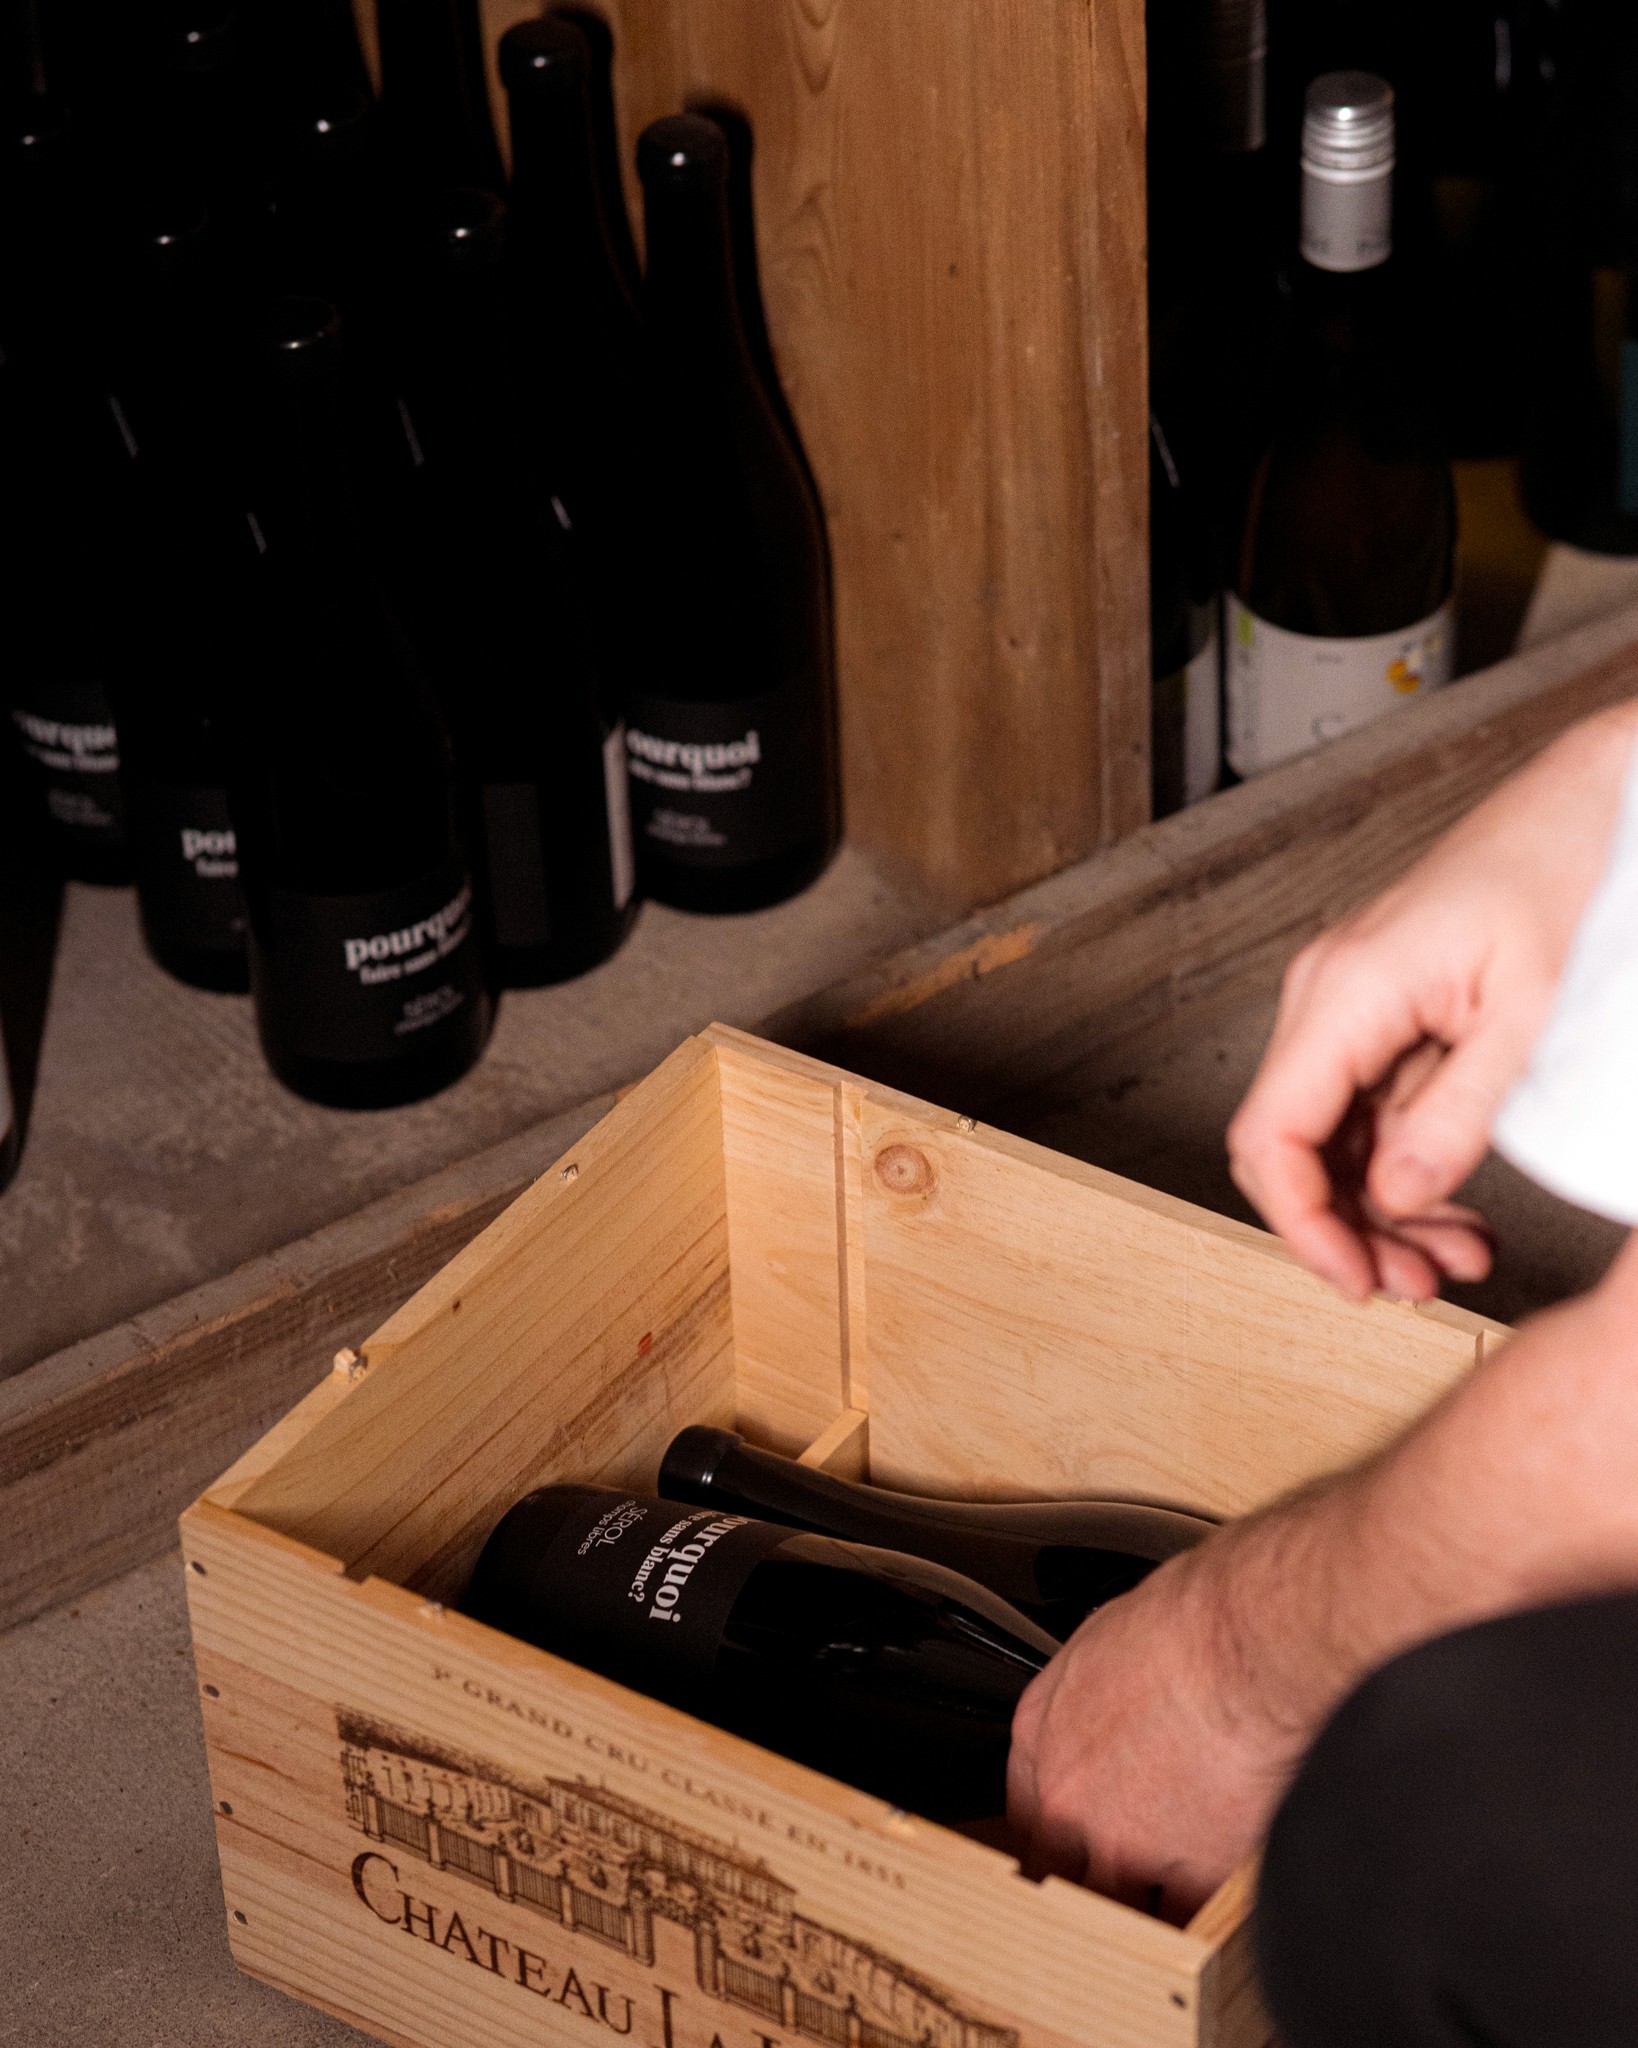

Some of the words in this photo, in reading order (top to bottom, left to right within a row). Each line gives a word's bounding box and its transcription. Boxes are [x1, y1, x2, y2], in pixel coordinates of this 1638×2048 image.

[627, 1545, 671, 1603] blanc?
[648, 1515, 748, 1623] ourquoi
[659, 1519, 693, 1545] sans
[463, 1679, 573, 1738] GRAND
[584, 1735, 649, 1773] CRU
[350, 1851, 635, 2036] CHATEAU
